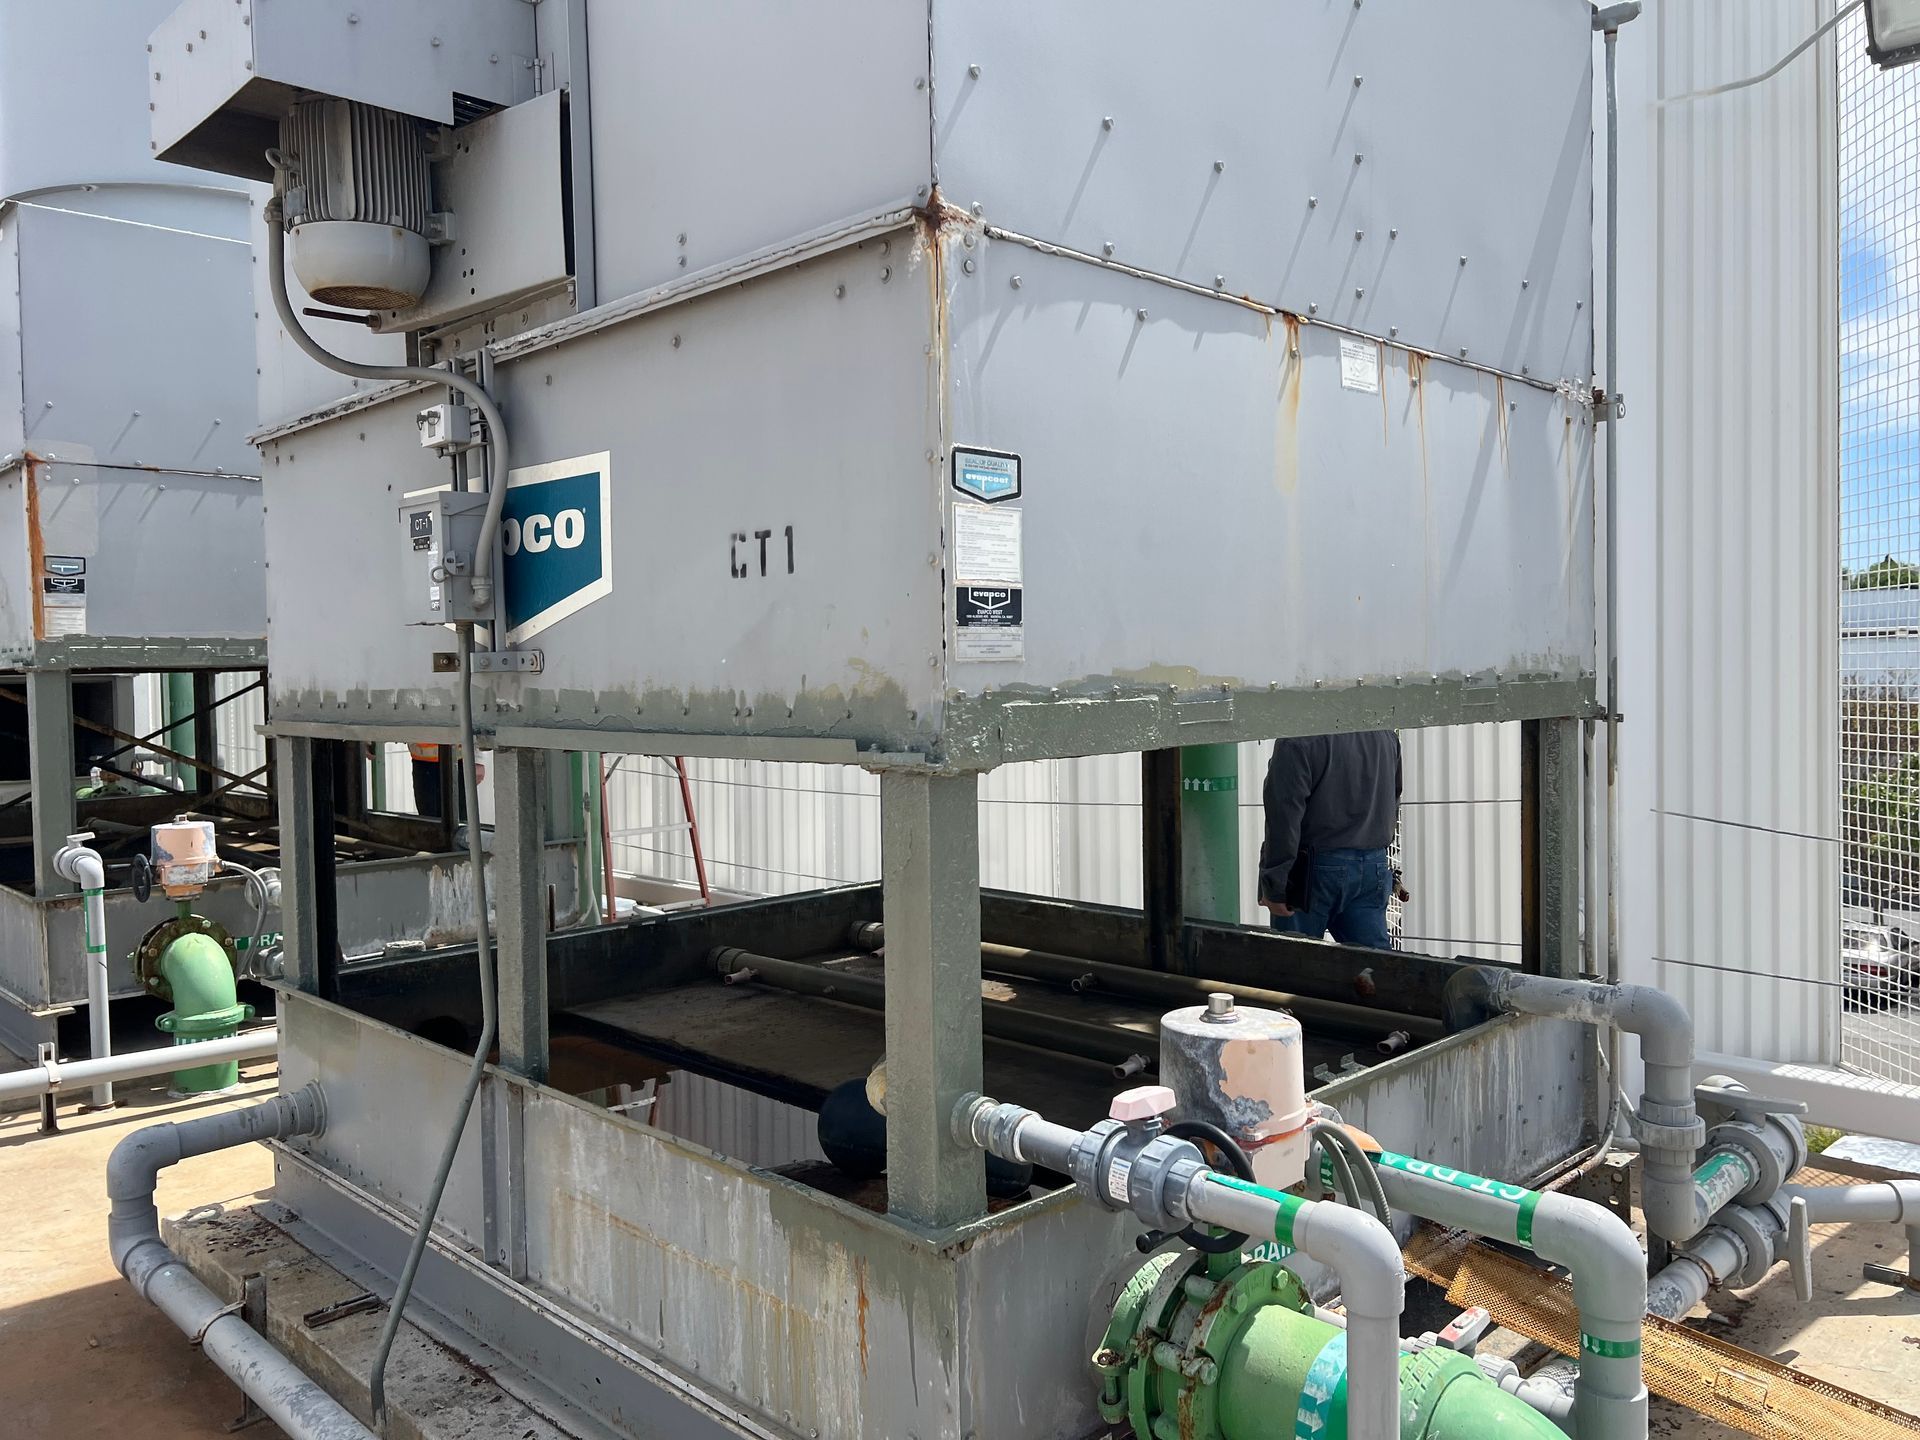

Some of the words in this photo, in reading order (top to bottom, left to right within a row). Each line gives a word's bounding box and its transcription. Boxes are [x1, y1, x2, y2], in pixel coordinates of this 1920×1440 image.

[965, 473, 1009, 488] evapcoat
[415, 518, 429, 531] CT-1
[973, 591, 1006, 601] evapco
